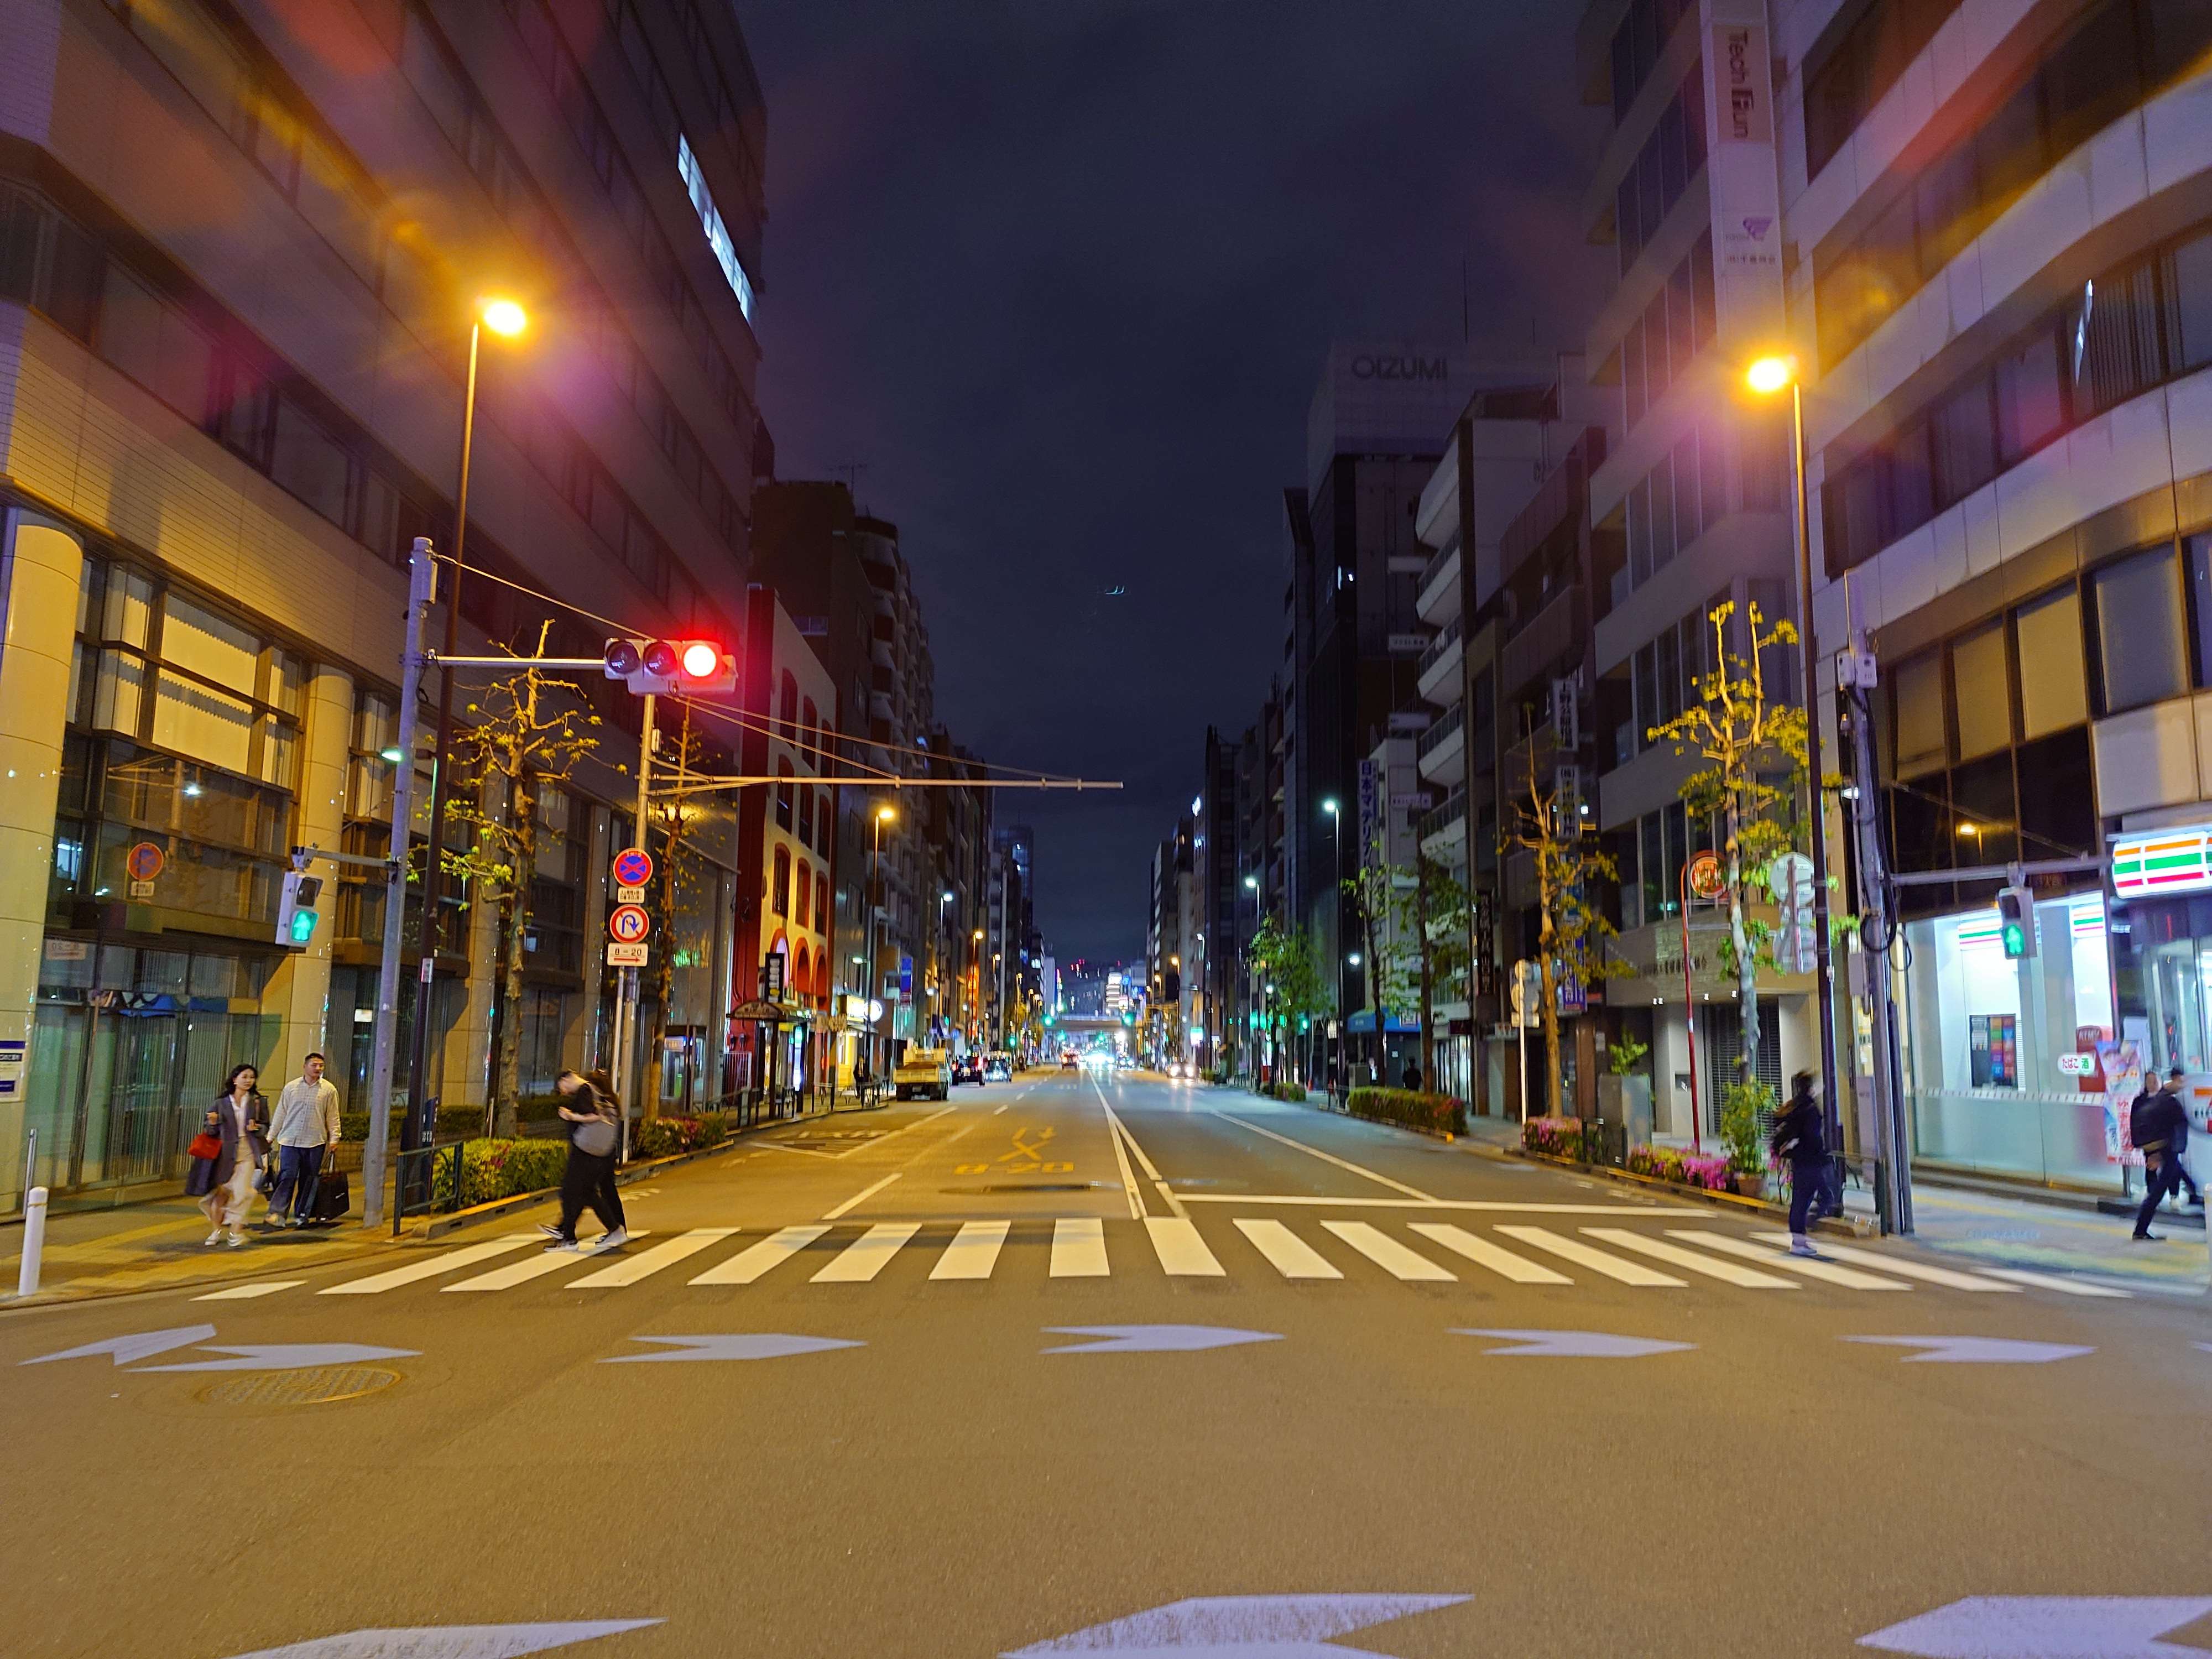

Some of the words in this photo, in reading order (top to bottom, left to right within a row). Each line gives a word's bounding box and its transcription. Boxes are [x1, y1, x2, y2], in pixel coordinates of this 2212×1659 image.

[1729, 30, 1749, 84] Tech
[1731, 88, 1754, 138] Fun
[1352, 357, 1448, 380] OIZUMI
[2062, 1057, 2079, 1070] たばこ
[2081, 1057, 2089, 1070] 酒
